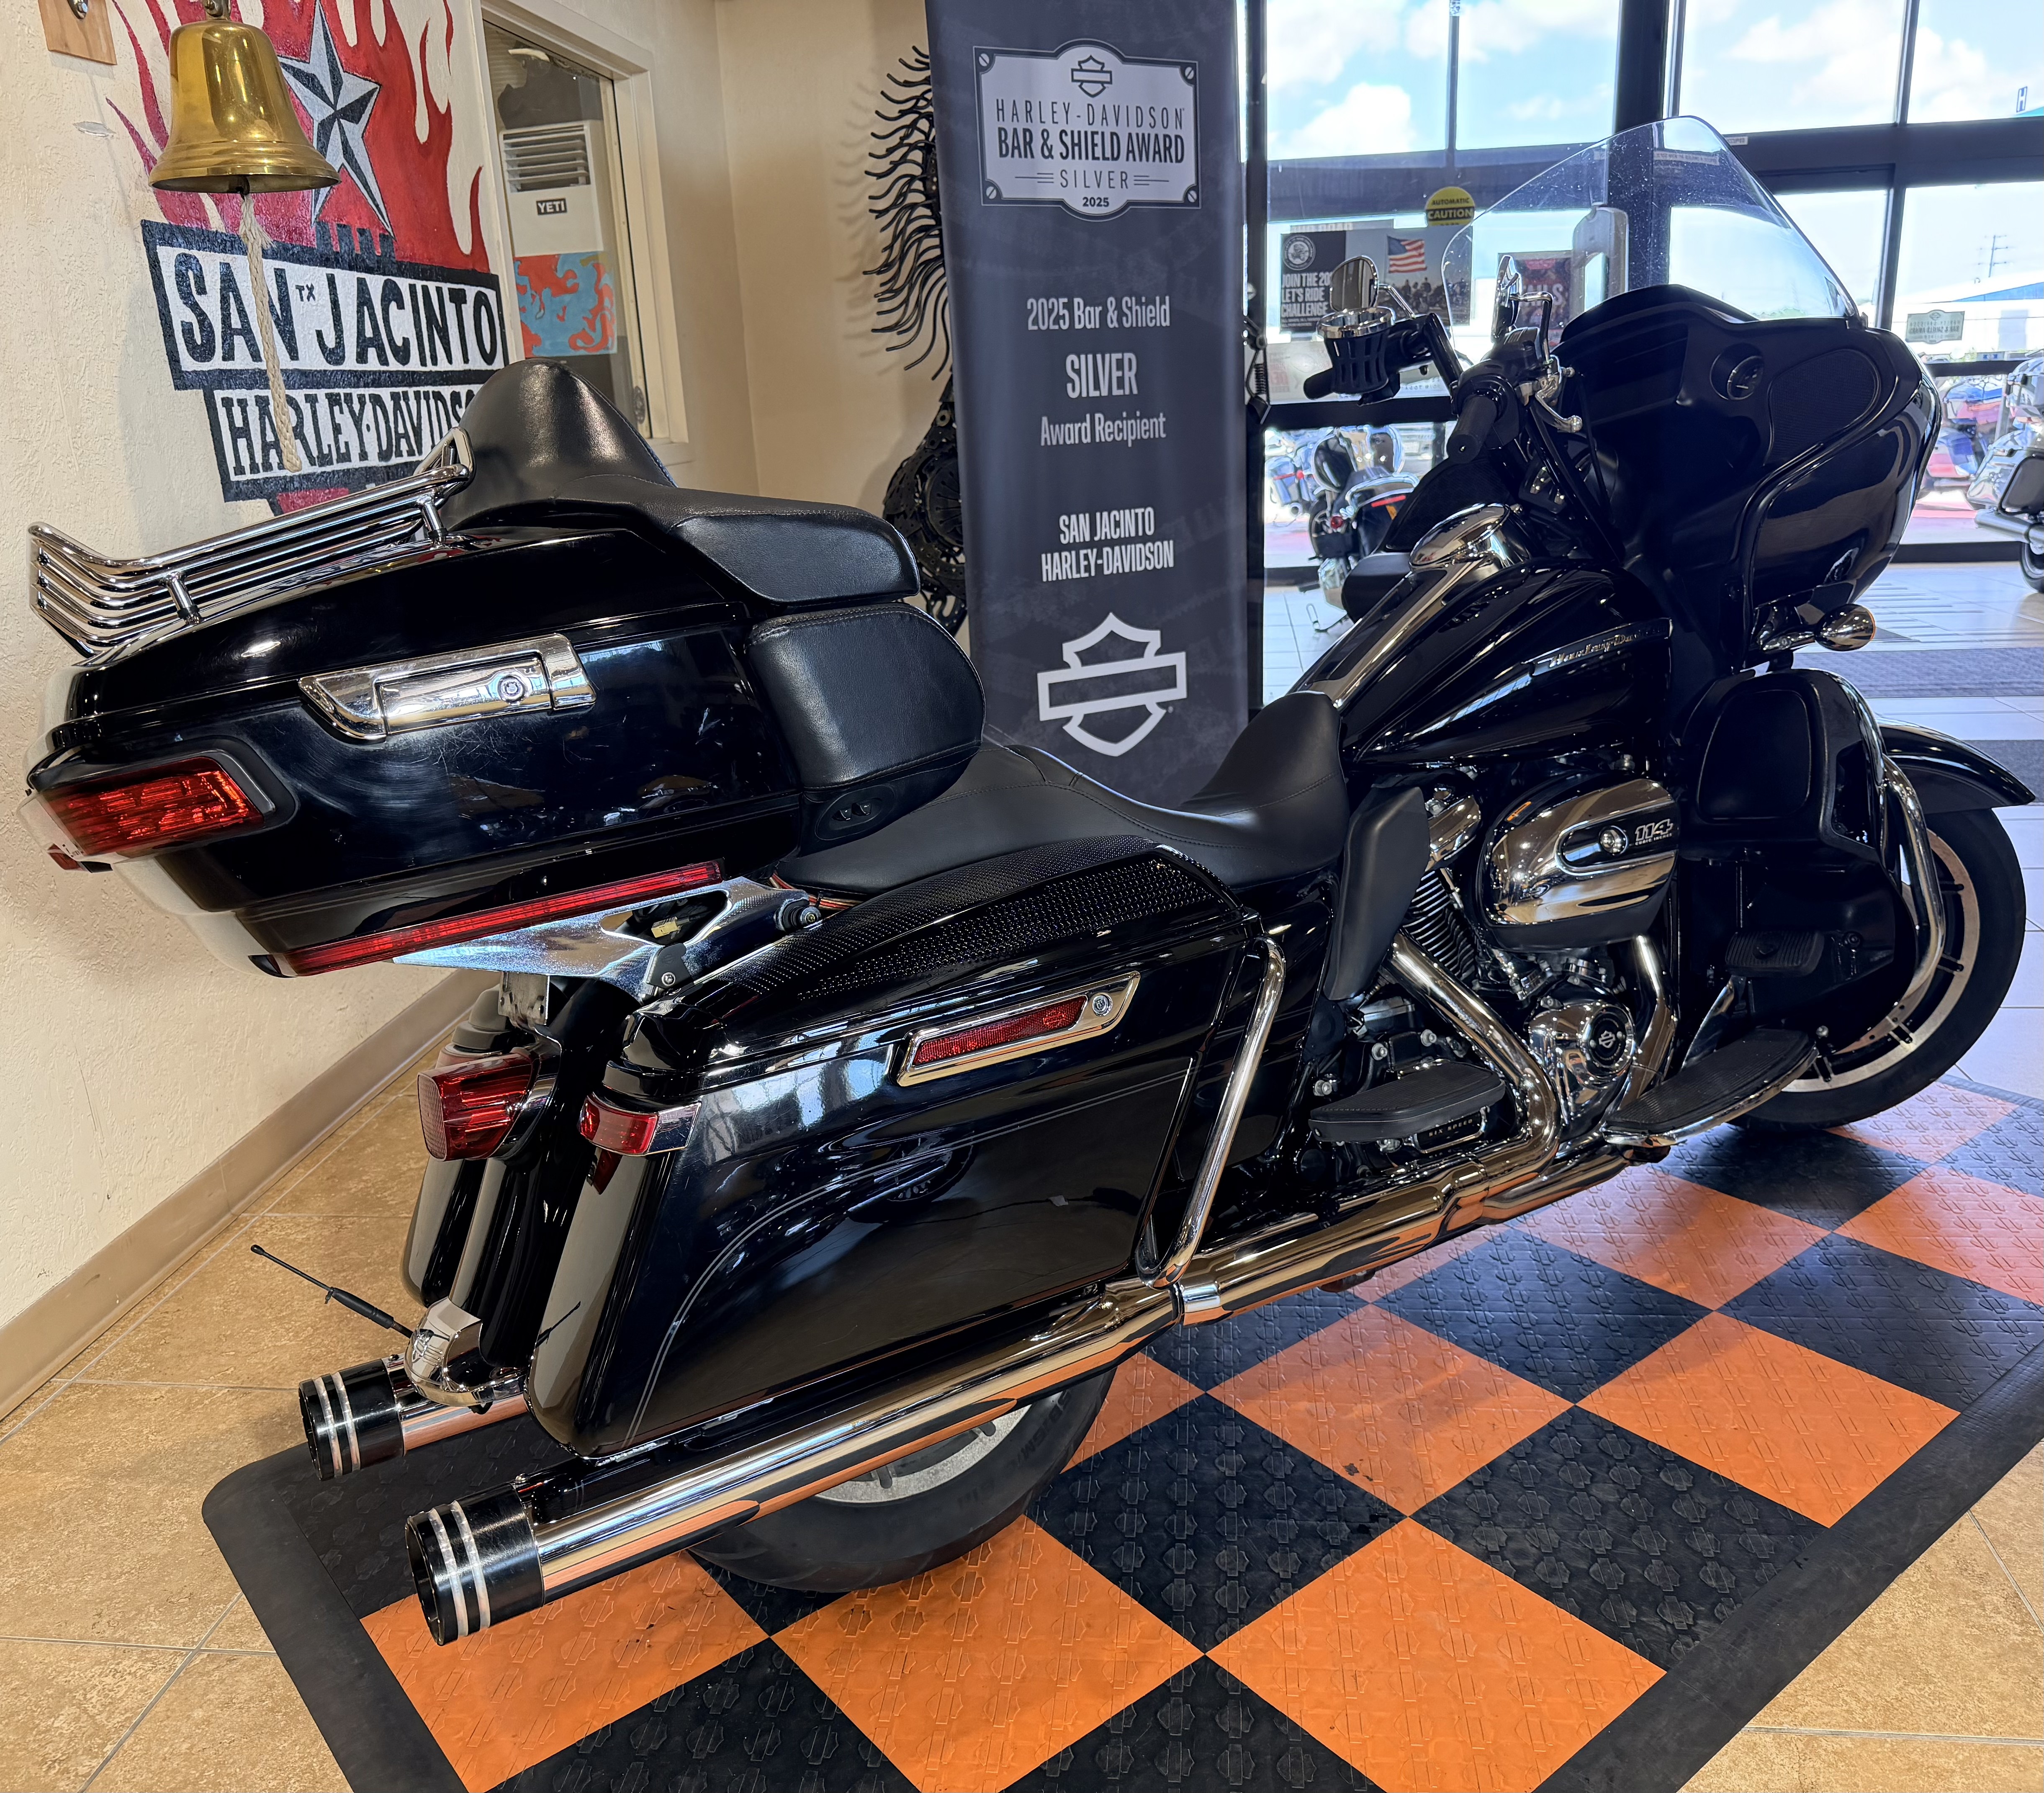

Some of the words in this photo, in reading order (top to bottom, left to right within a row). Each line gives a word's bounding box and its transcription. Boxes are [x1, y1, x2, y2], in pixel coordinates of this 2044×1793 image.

[996, 99, 1183, 130] HARLEY-DAVIDSON
[998, 127, 1034, 159] BAR
[1041, 129, 1054, 159] &
[1059, 129, 1121, 161] SHIELD
[1126, 132, 1184, 163] AWARD
[1060, 170, 1128, 189] SILVER
[538, 201, 565, 213] YETI
[1082, 197, 1109, 207] 2025
[1428, 208, 1473, 219] CAUTION
[1282, 273, 1301, 288] JOIN
[1301, 273, 1318, 287] THE
[1319, 272, 1333, 286] 20
[295, 284, 316, 303] TX
[1305, 287, 1325, 301] RIDE
[174, 253, 299, 362] SAN
[315, 273, 497, 366] JACINTO
[1027, 298, 1069, 330] 2025
[1073, 297, 1103, 329] Bar
[1107, 296, 1119, 328] &
[1122, 295, 1170, 328] Shield
[1281, 302, 1328, 318] CHALLENGE
[1066, 352, 1138, 398] SILVER
[1041, 413, 1091, 446] Award
[1095, 411, 1166, 448] Recipient
[1059, 513, 1090, 544] SAN
[1094, 507, 1155, 541] JACINTO
[1041, 540, 1174, 582] HARLEY-DAVIDSON
[1635, 819, 1673, 841] 114
